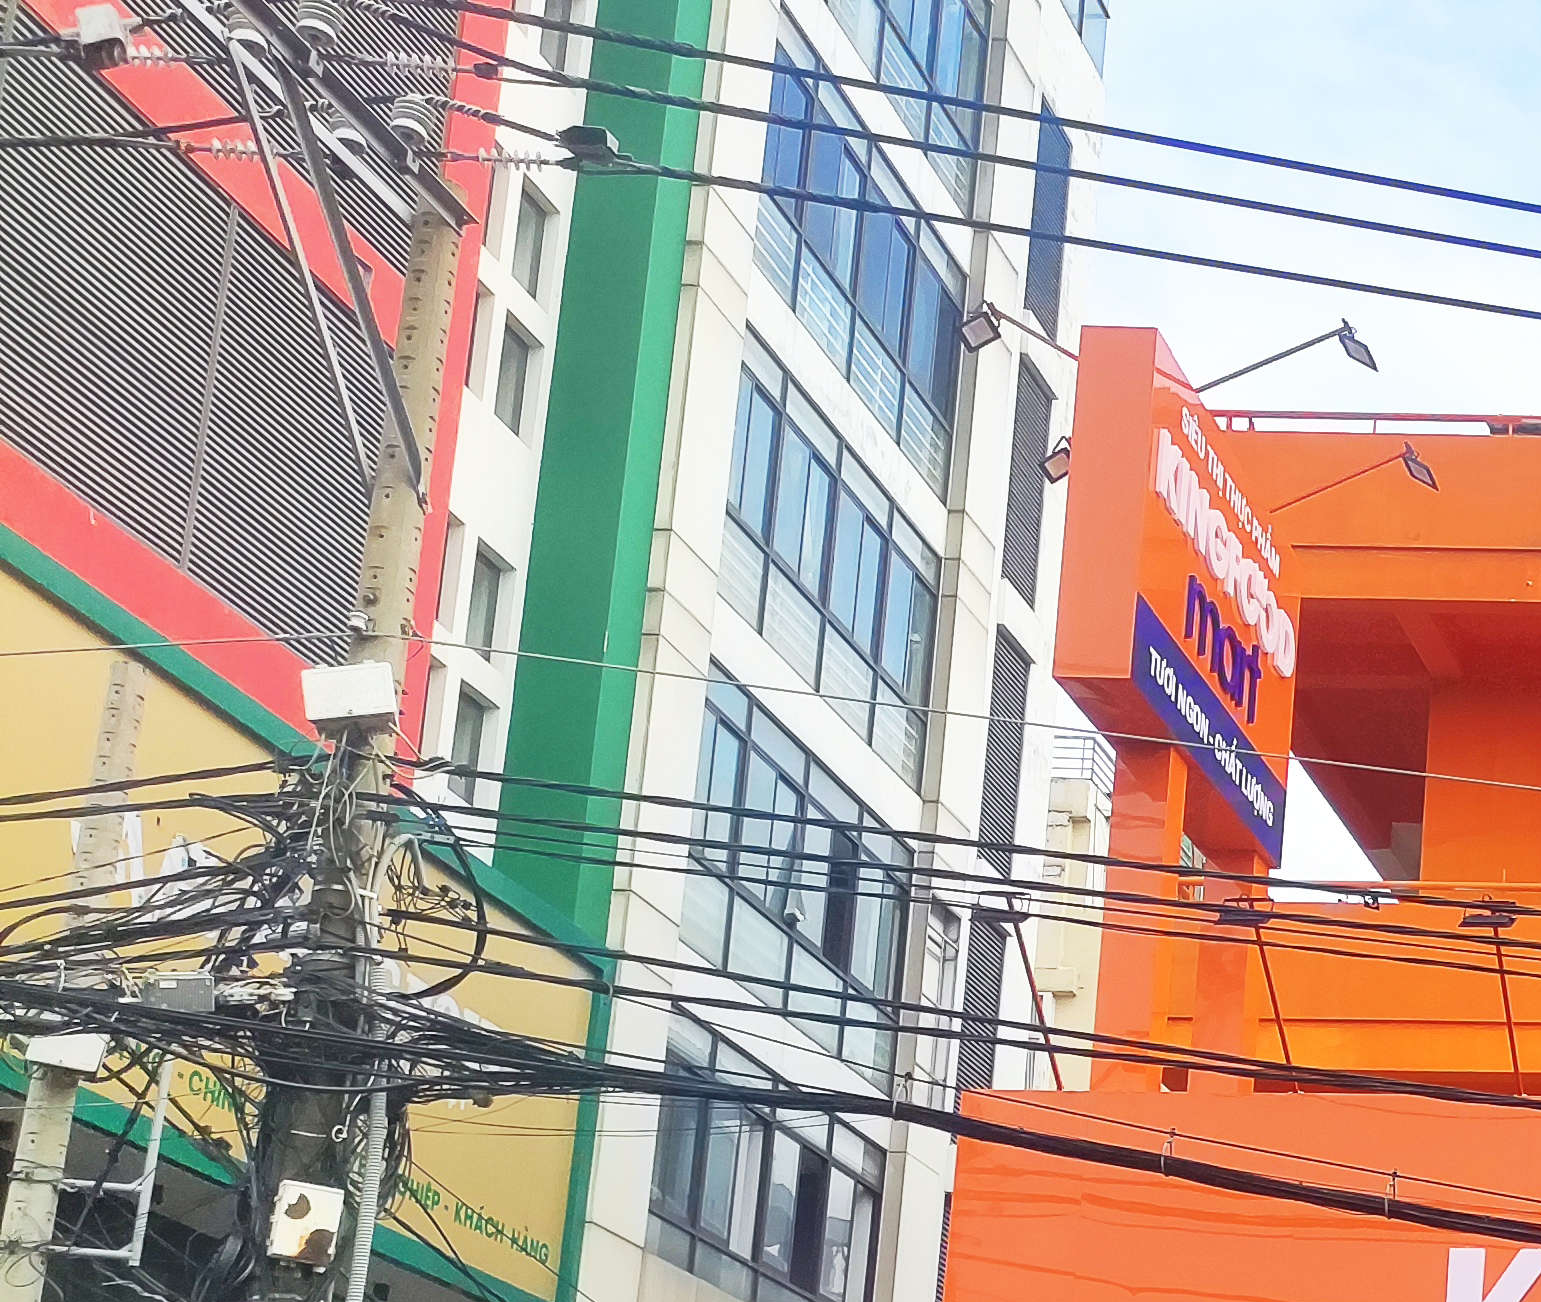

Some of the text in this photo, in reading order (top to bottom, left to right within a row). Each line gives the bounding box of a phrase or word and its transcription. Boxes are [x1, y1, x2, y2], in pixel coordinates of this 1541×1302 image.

[1155, 428, 1295, 678] KINGFOOD
[1181, 405, 1280, 579] SIÊU THỊ THỰC PHẨM
[1184, 574, 1261, 724] mart
[1149, 646, 1274, 828] TƯƠI NGON CHẤT LƯỢNG
[453, 1202, 550, 1264] KHÁCH HÀNG
